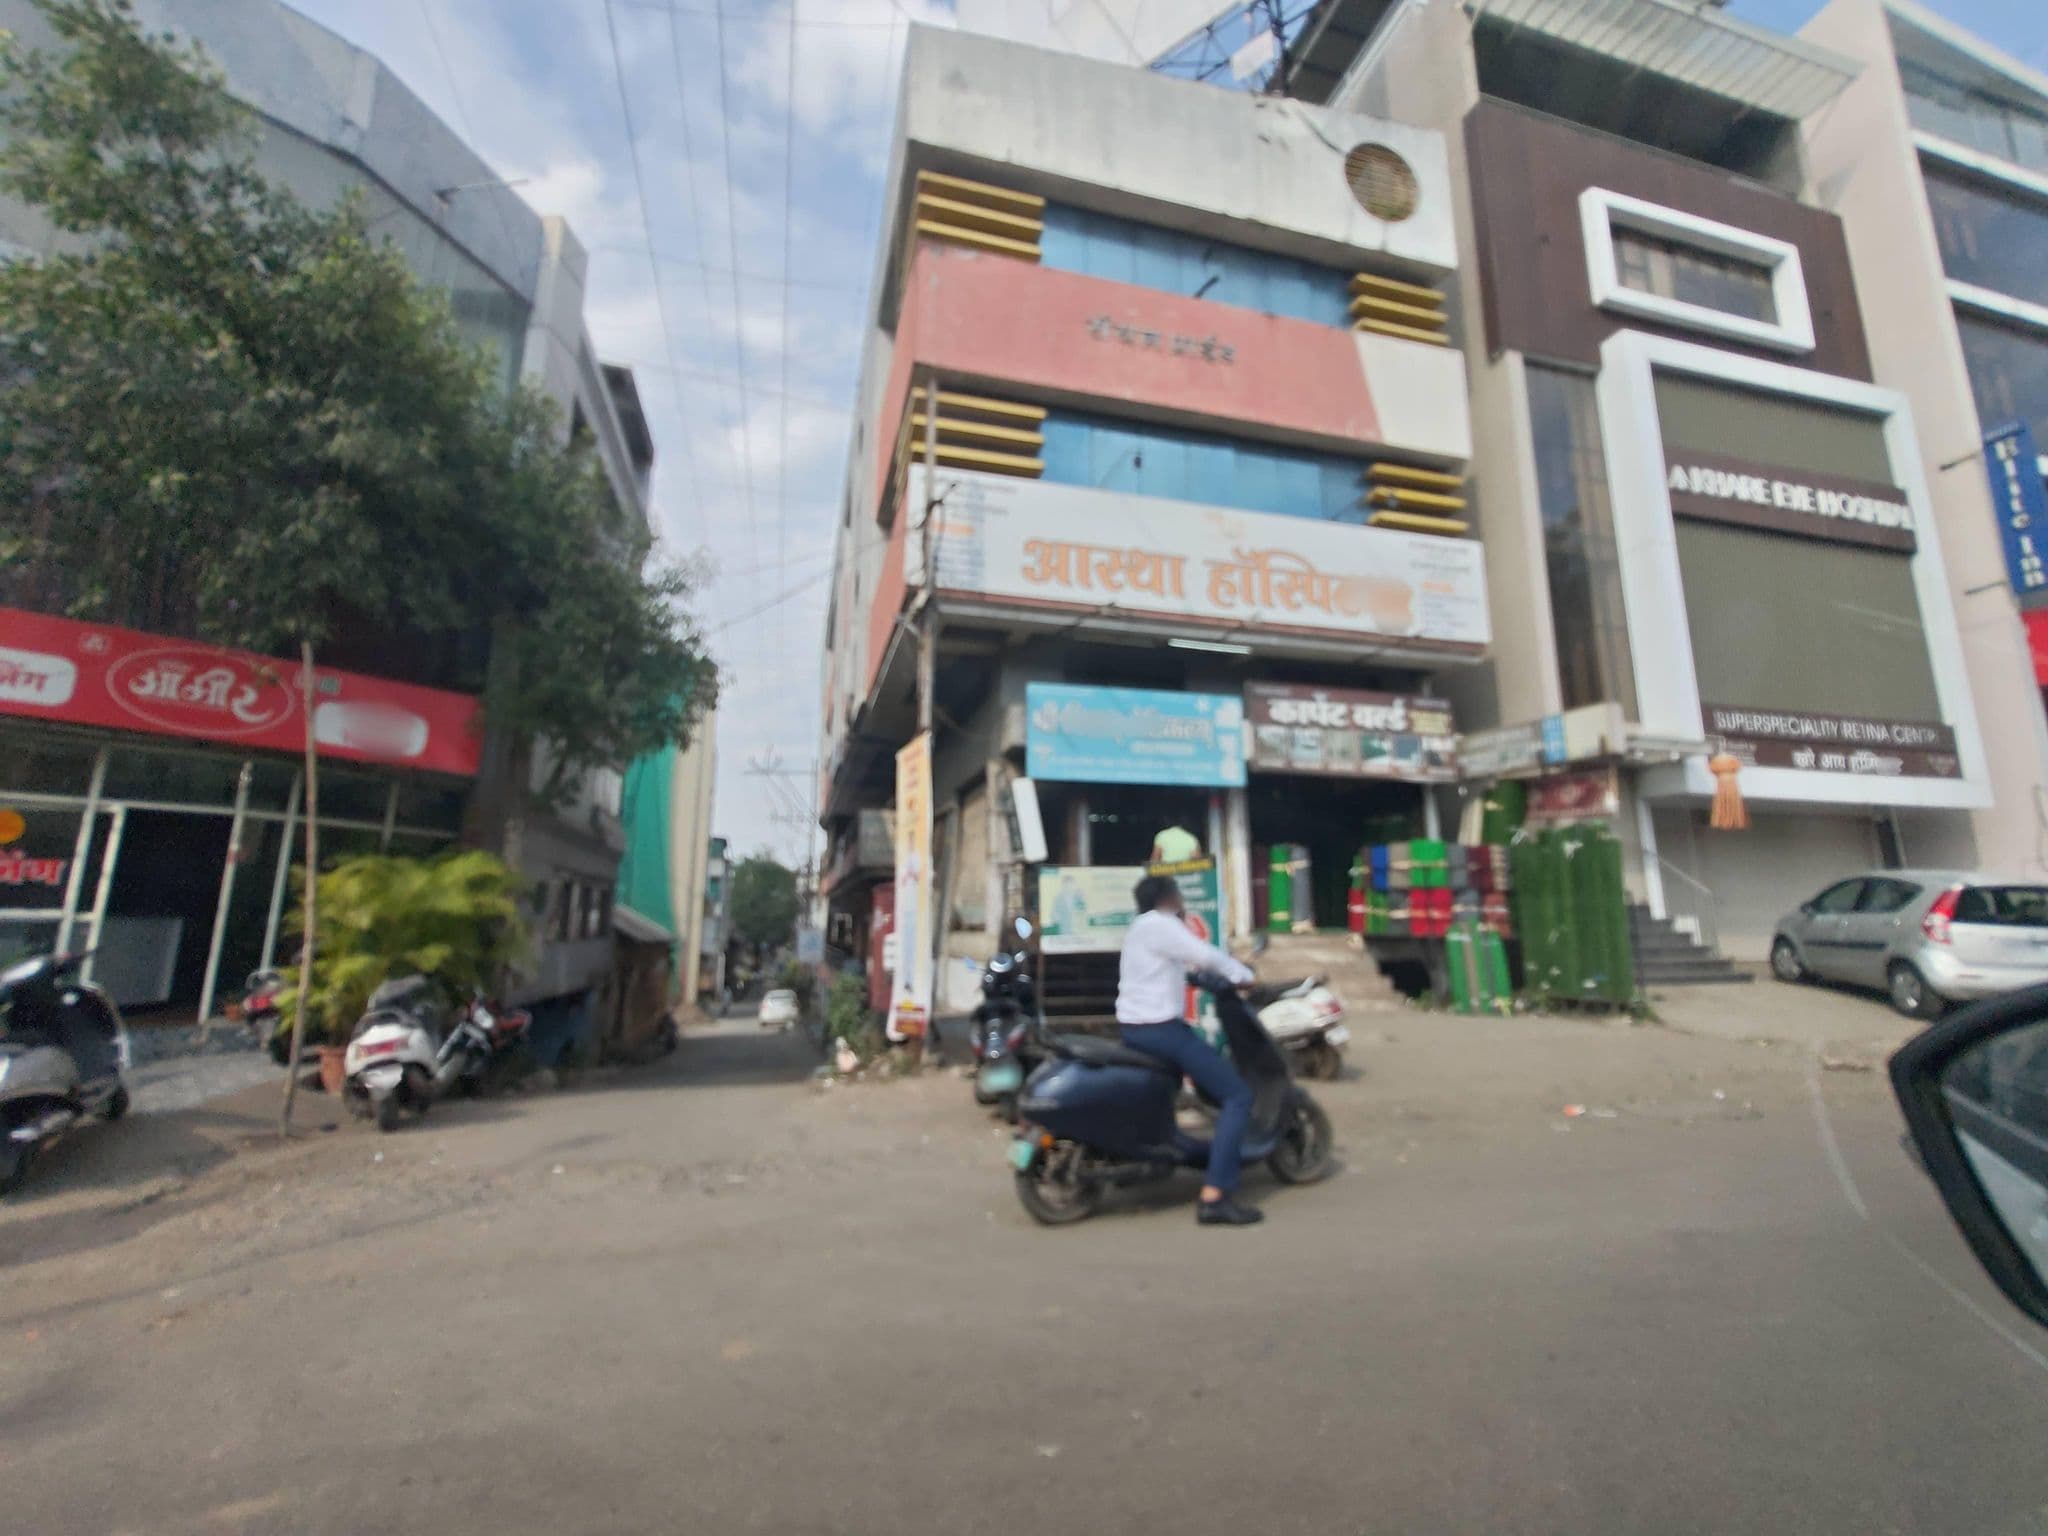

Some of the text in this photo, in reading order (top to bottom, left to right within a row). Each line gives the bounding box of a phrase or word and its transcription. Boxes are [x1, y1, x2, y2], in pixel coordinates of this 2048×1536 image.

[1772, 480, 1816, 513] EYE
[1023, 539, 1178, 599] आस्था
[1203, 547, 1413, 634] हॉस्पिट
[1713, 711, 1838, 740] SUPERSPECIALITY
[1842, 720, 1889, 741] RETINA
[1849, 749, 1903, 776] हॉस्पि
